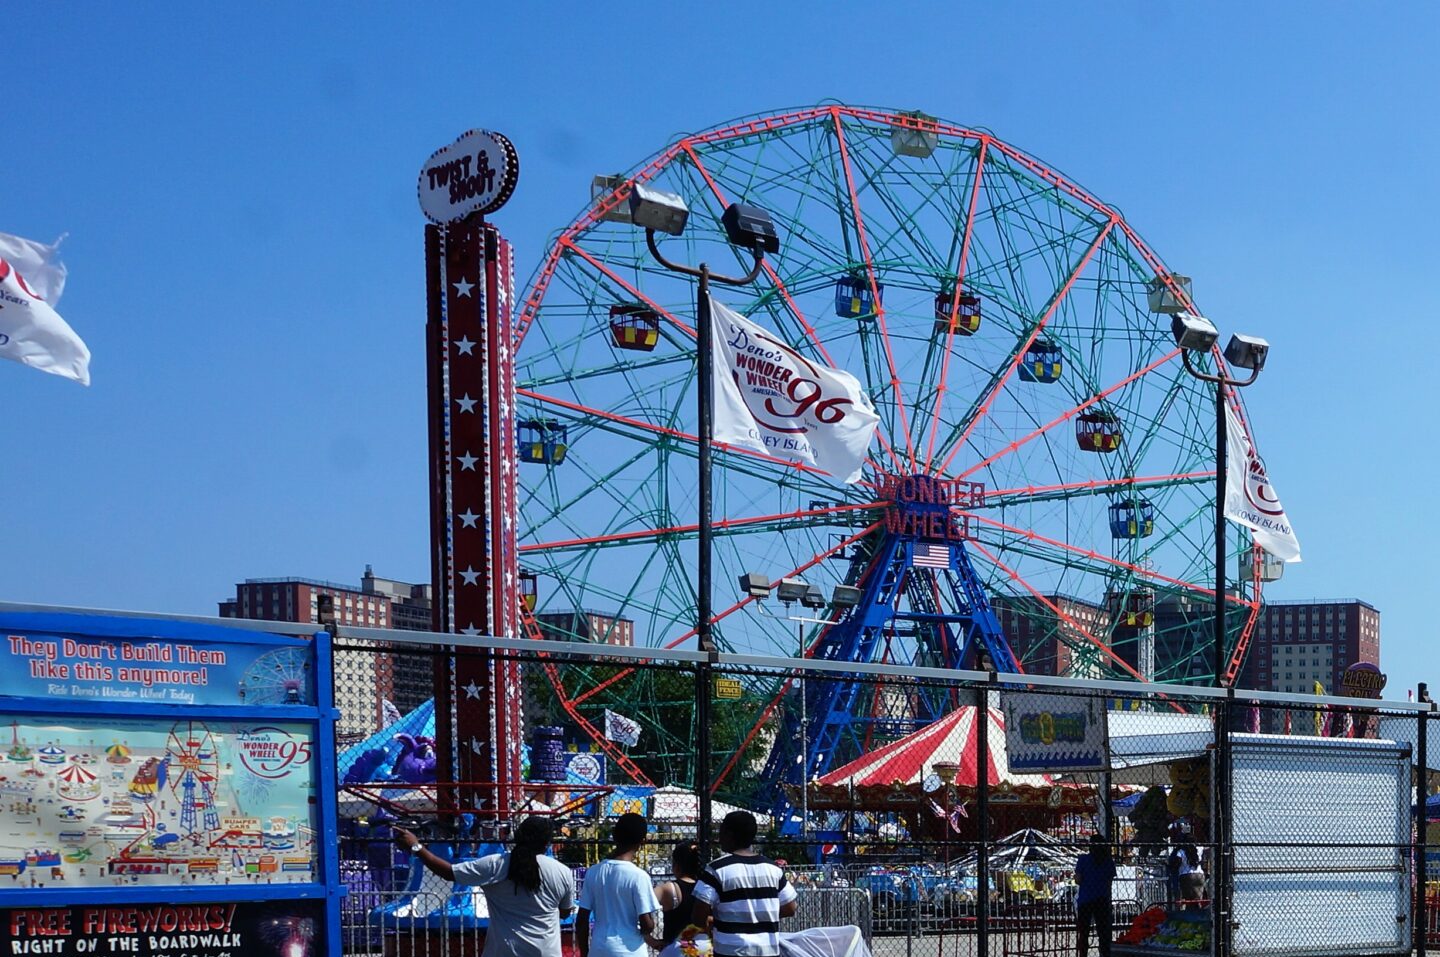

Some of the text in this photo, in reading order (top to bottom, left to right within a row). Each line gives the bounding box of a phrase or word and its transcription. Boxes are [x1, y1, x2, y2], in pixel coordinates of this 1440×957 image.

[427, 155, 472, 191] TWIST
[449, 169, 496, 205] SHOUT
[728, 324, 784, 362] Deno's
[736, 352, 794, 383] WONDER
[746, 371, 786, 396] WHEEL
[764, 377, 854, 424] 96
[783, 438, 819, 458] ISLAD
[876, 473, 985, 509] WONDER
[884, 508, 980, 542] WHEEL
[1261, 519, 1291, 535] ISLAND
[7, 635, 226, 665] They Don't Build Them
[30, 659, 209, 687] like this anymore!
[48, 684, 68, 695] Ride
[102, 687, 138, 698] Wonder
[140, 687, 166, 699] Wheel
[169, 688, 195, 704] Today
[243, 742, 279, 750] WONDER
[249, 750, 276, 758] WHEEL
[9, 903, 237, 936] FREE FIREWORKS!
[11, 934, 241, 955] RIGHT ON THE BOARDWALK
